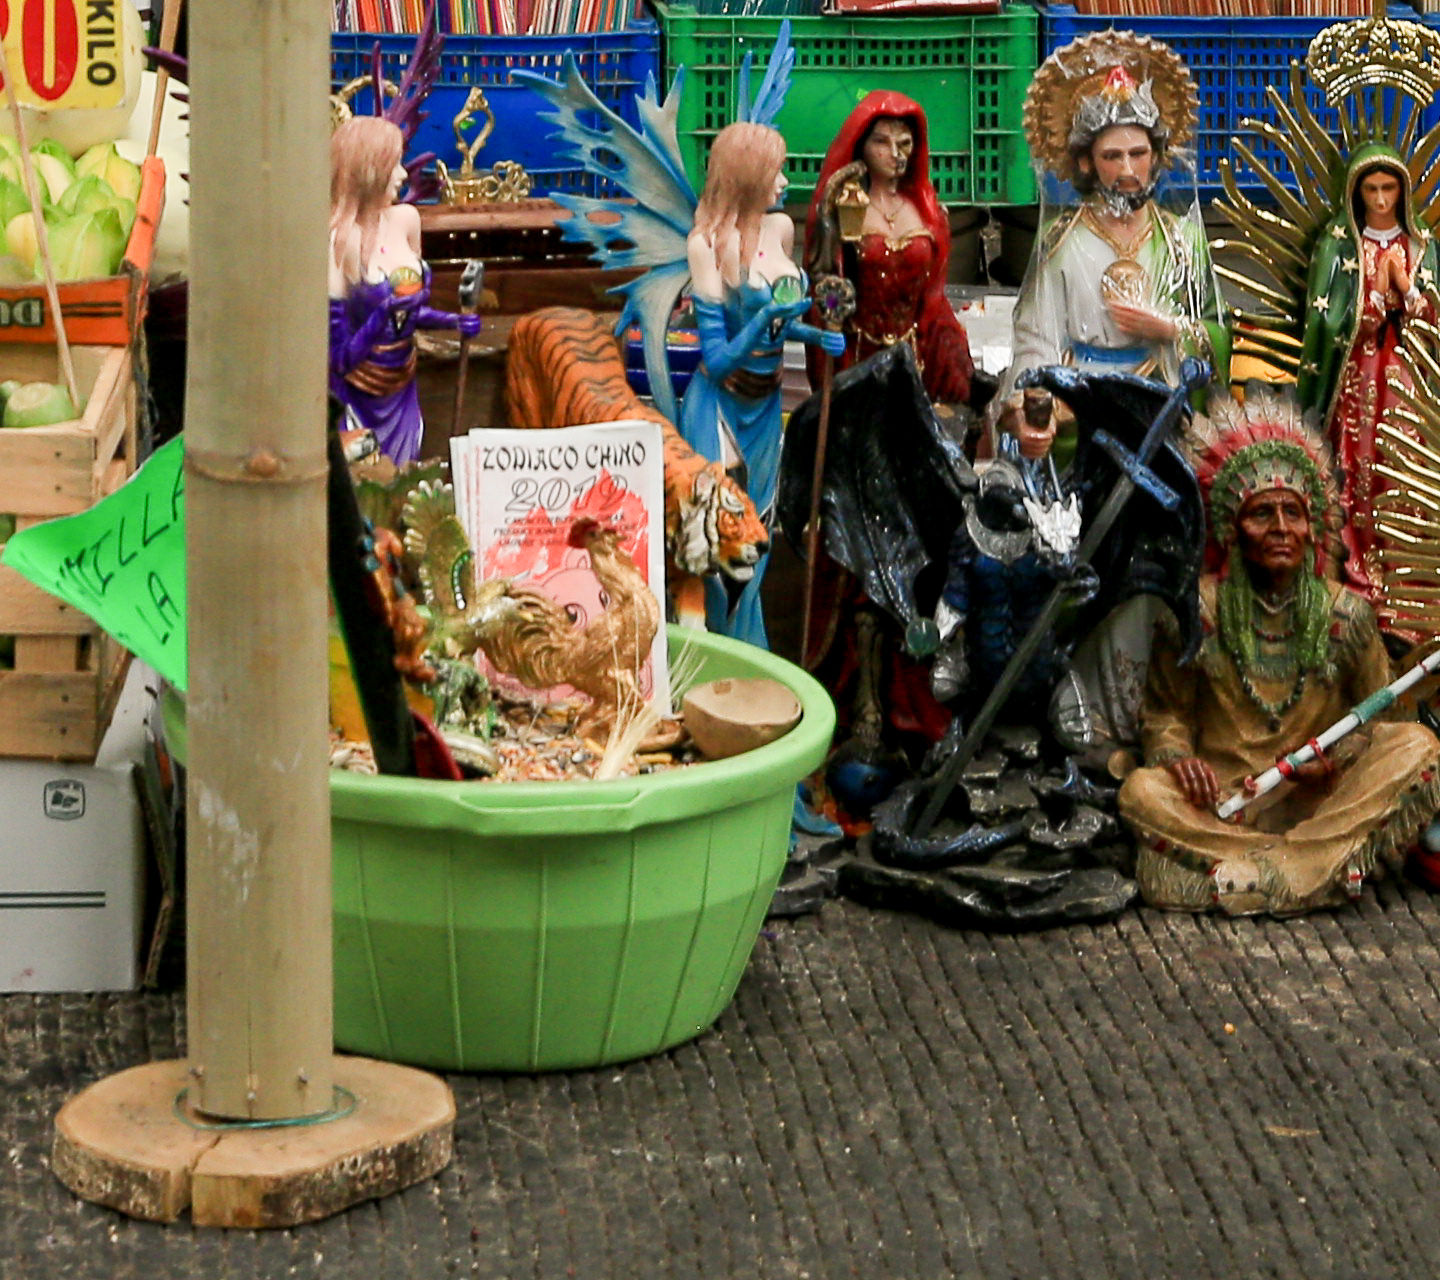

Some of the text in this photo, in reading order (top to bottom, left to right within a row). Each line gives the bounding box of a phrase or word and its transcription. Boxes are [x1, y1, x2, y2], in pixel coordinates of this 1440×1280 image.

[85, 0, 117, 87] KILO
[482, 440, 646, 471] ZODIACO CHINO
[504, 472, 630, 513] 2019
